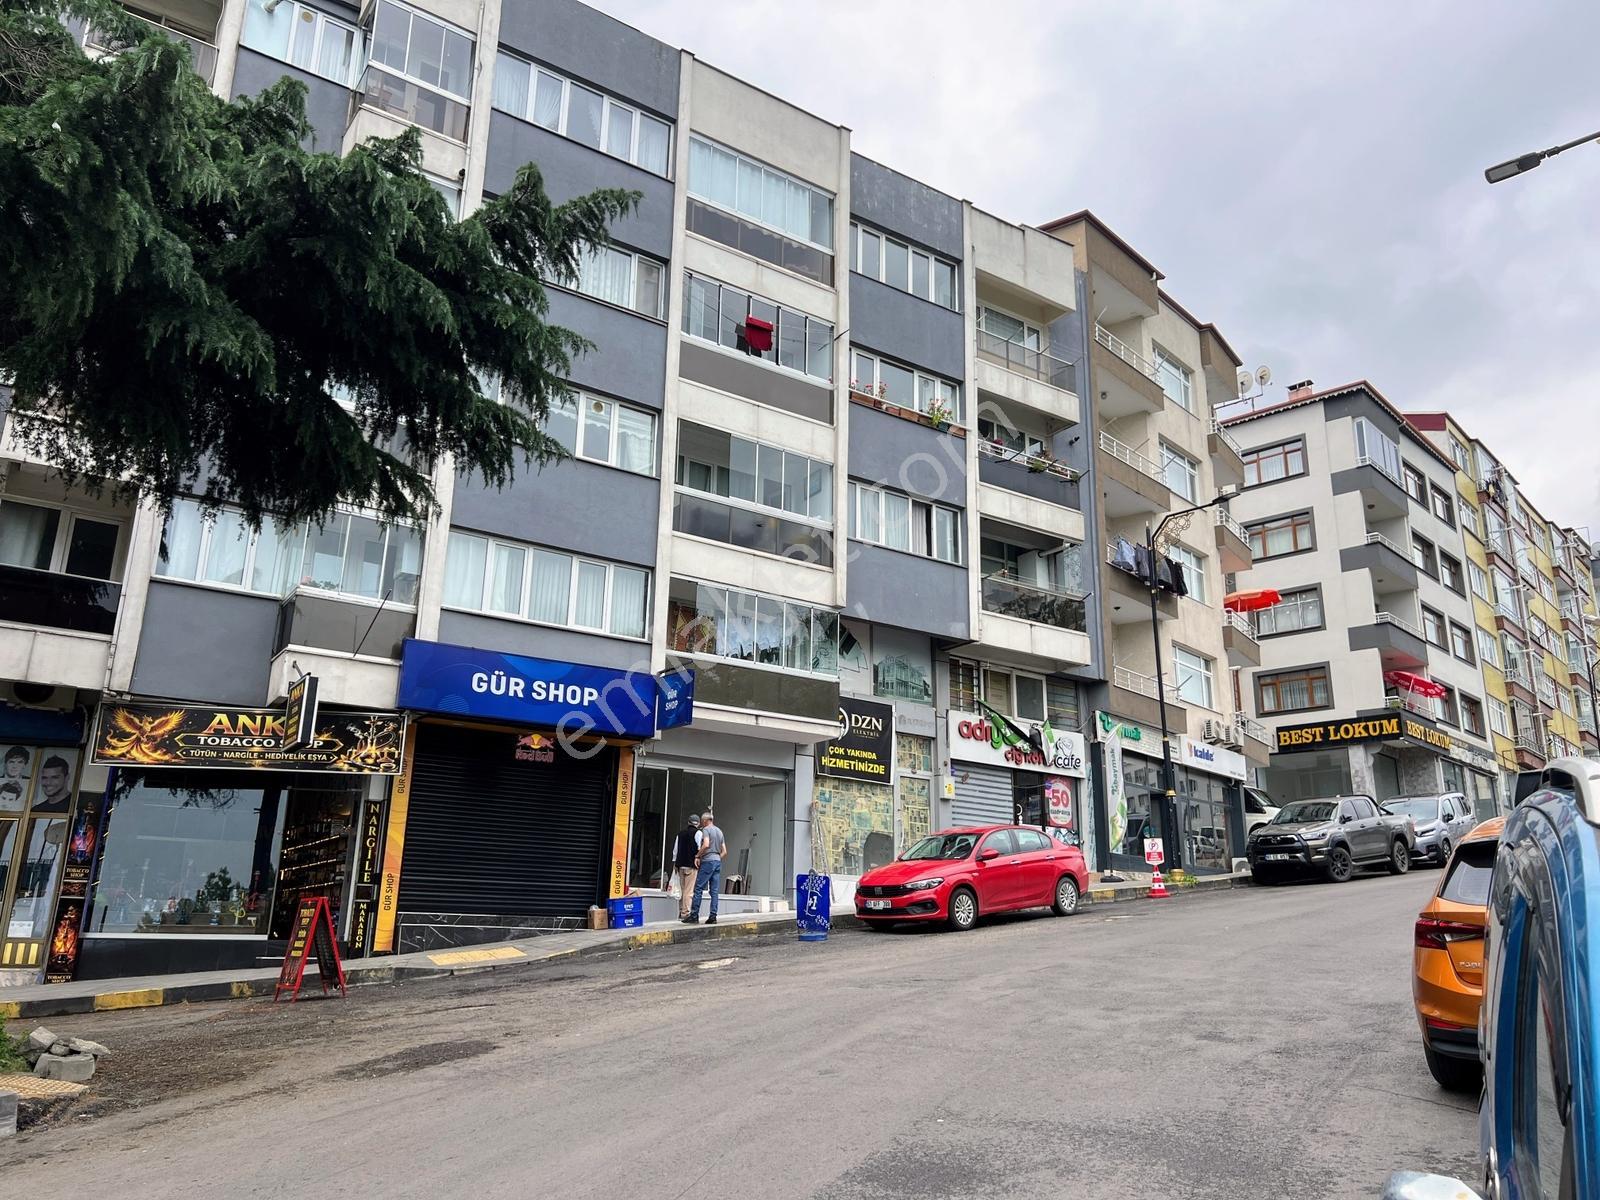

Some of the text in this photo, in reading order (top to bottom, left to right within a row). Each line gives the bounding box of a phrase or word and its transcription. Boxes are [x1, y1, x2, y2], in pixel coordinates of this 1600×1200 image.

[472, 670, 599, 707] GÜR SHOP
[203, 713, 287, 736] ANK
[851, 713, 883, 731] DZN
[1278, 719, 1400, 746] BEST LOKUM
[197, 736, 275, 748] TOBACCO
[1406, 720, 1451, 750] BEST LOKUM
[190, 749, 328, 762] TÜTÜN NARGİLE HEDİYELİK EŞYA
[829, 746, 877, 760] ÇOK YAKINDA
[1055, 755, 1081, 770] cafe
[821, 756, 885, 775] HİZMETİNİZDE
[363, 803, 380, 883] NARGİLE
[355, 903, 367, 949] MAKARON
